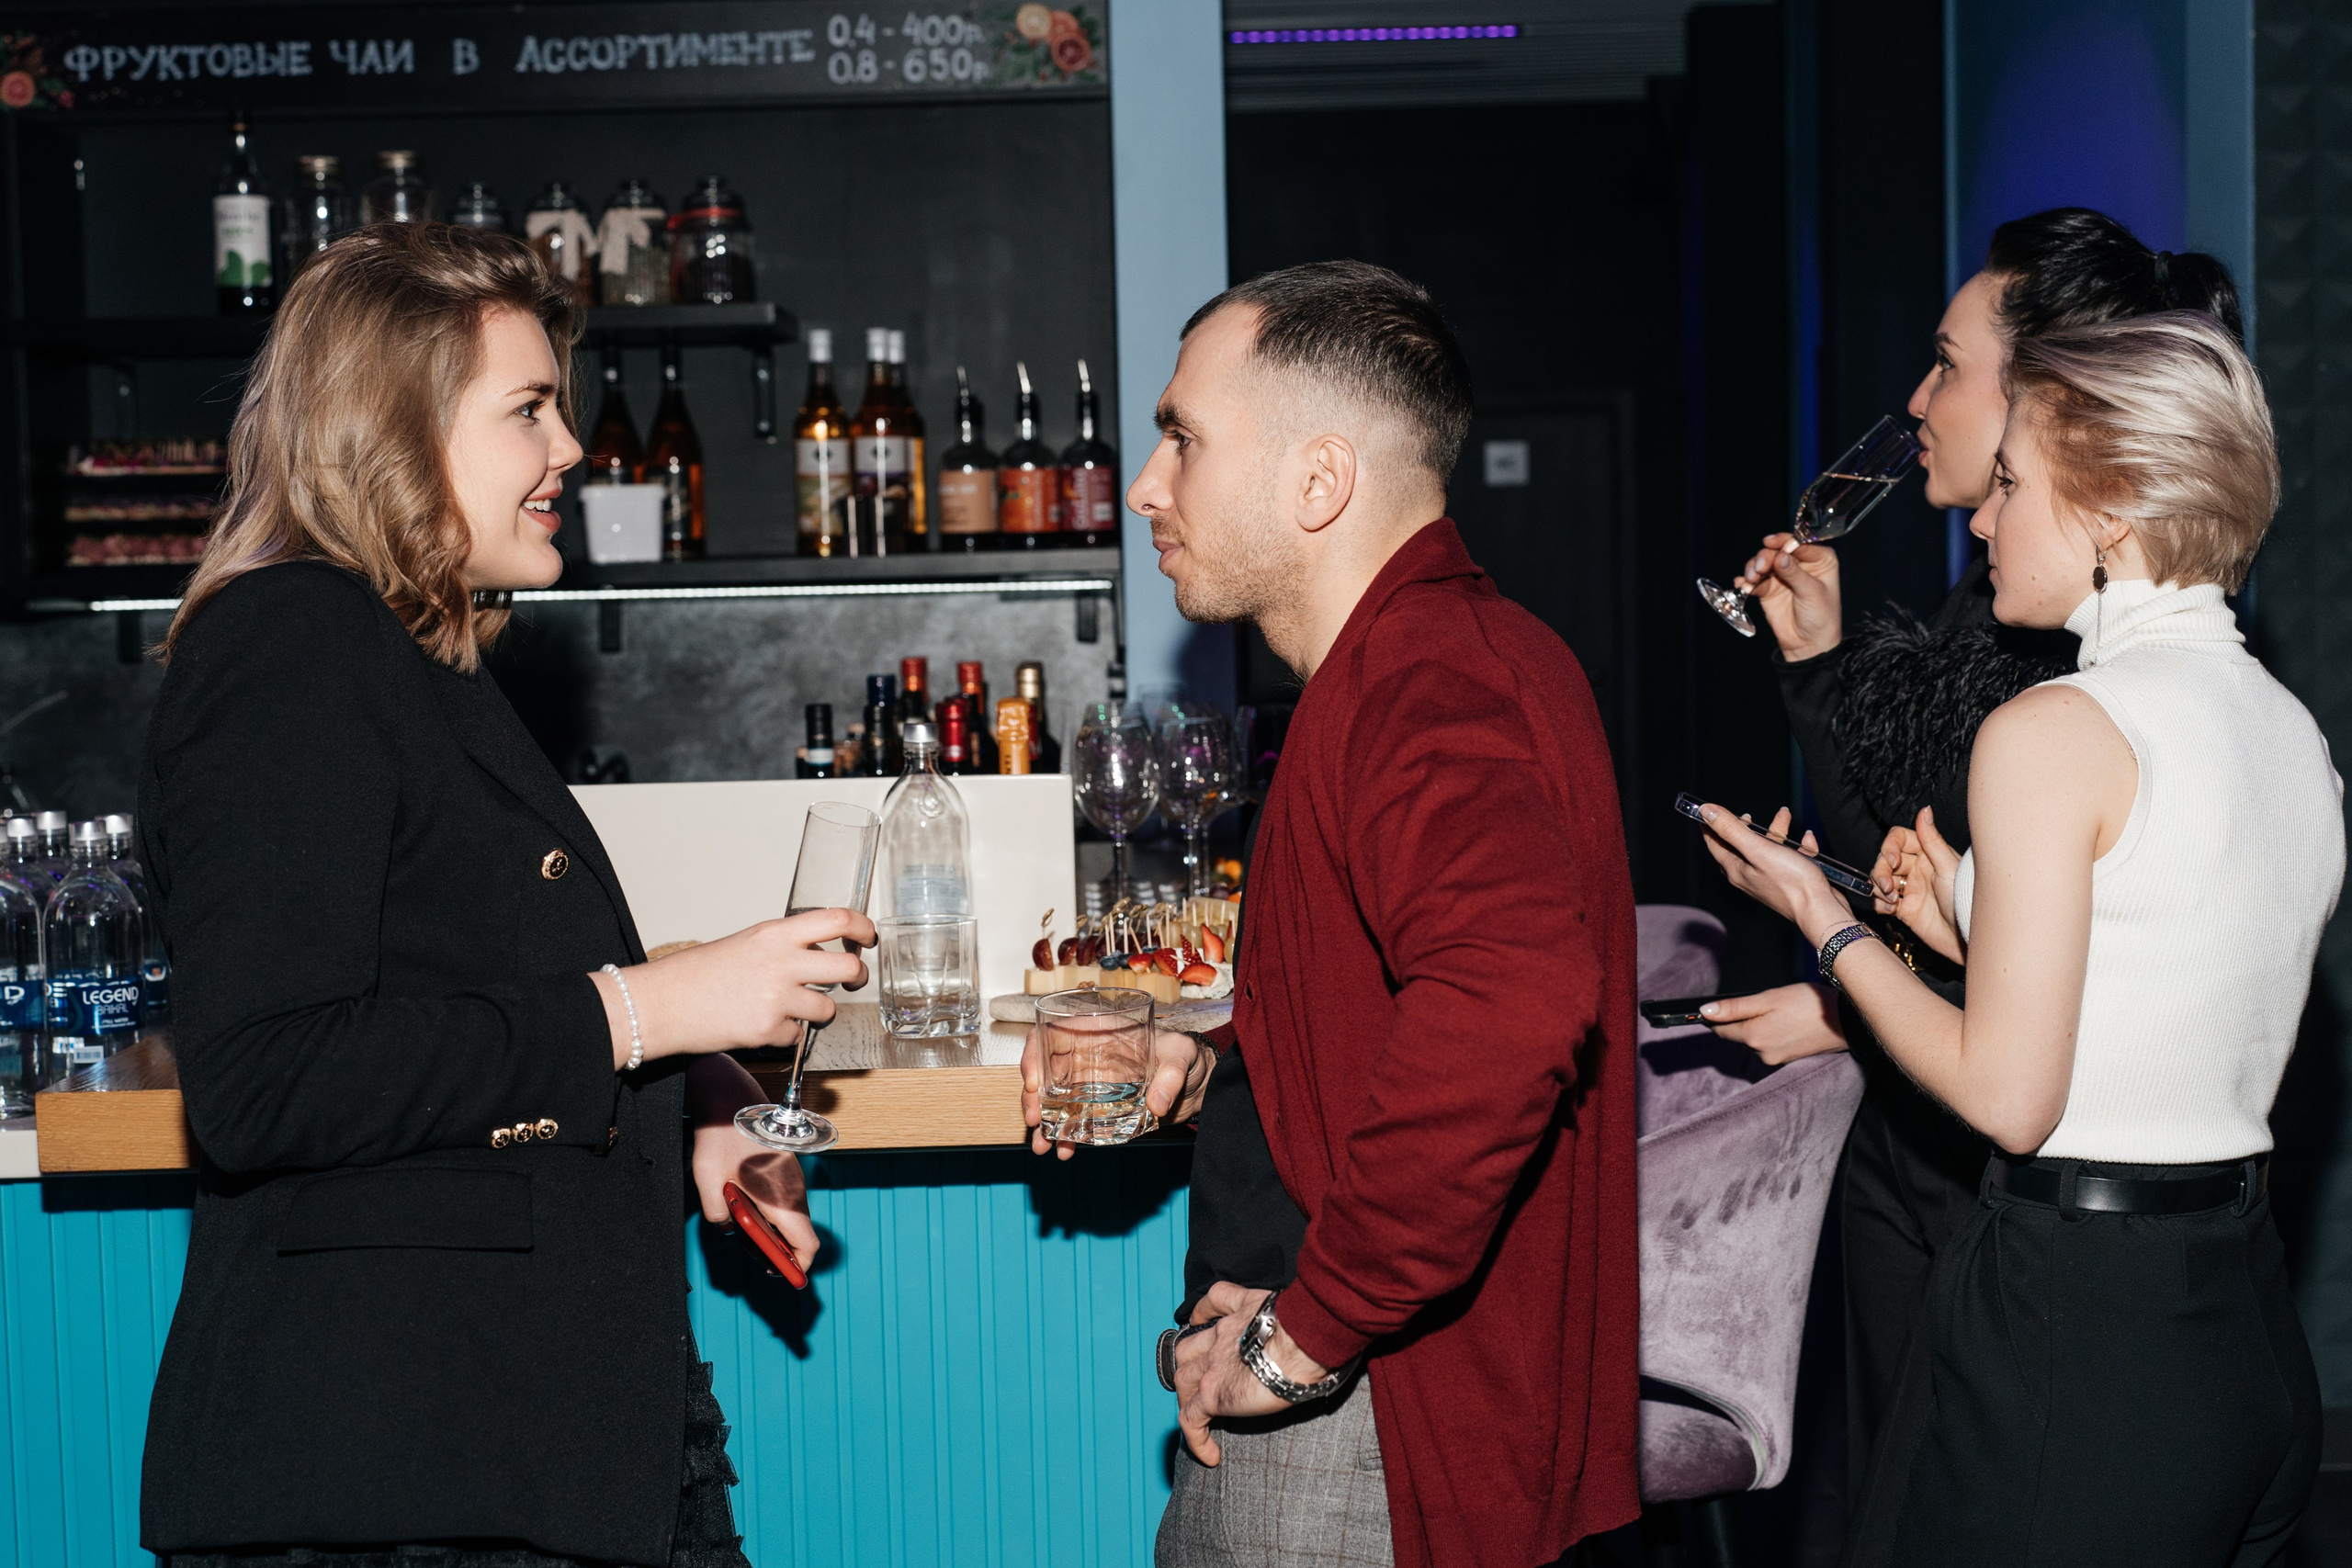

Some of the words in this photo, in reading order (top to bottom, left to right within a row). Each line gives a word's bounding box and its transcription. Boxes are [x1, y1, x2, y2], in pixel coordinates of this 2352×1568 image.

[63, 41, 313, 83] ФРУКТОВЫЕ
[452, 37, 481, 75] В
[514, 29, 816, 73] АССОРТИМЕНТЕ
[83, 987, 139, 1005] LEGEND
[97, 1003, 129, 1016] BAIKAL
